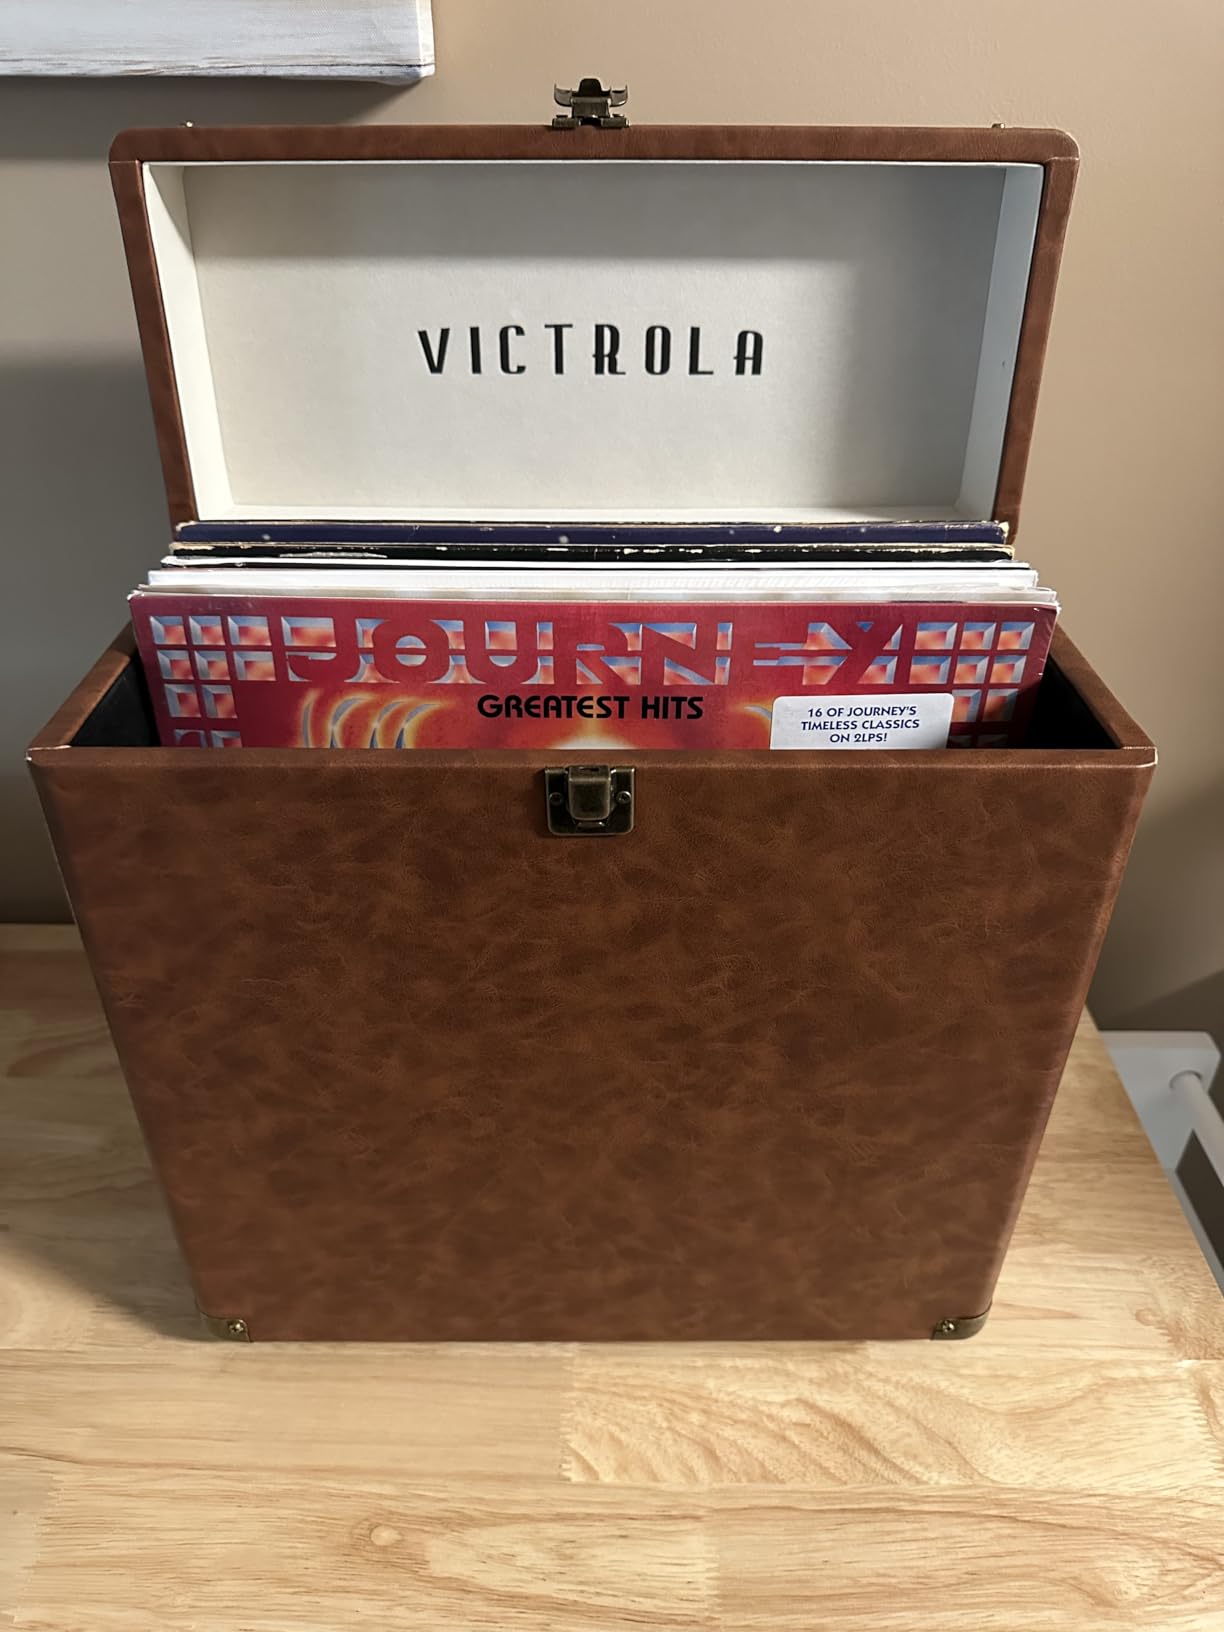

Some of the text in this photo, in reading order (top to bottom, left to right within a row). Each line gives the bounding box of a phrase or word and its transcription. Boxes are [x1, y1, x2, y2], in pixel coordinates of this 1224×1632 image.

[417, 323, 764, 376] VICTROLA
[284, 617, 904, 686] JOURNEY
[477, 694, 703, 719] GREATEST HITS
[807, 706, 917, 718] 16 OF JOURNEY'S
[801, 719, 920, 731] TIMELESS CLASSICS
[829, 733, 888, 743] ON 2LPS!
